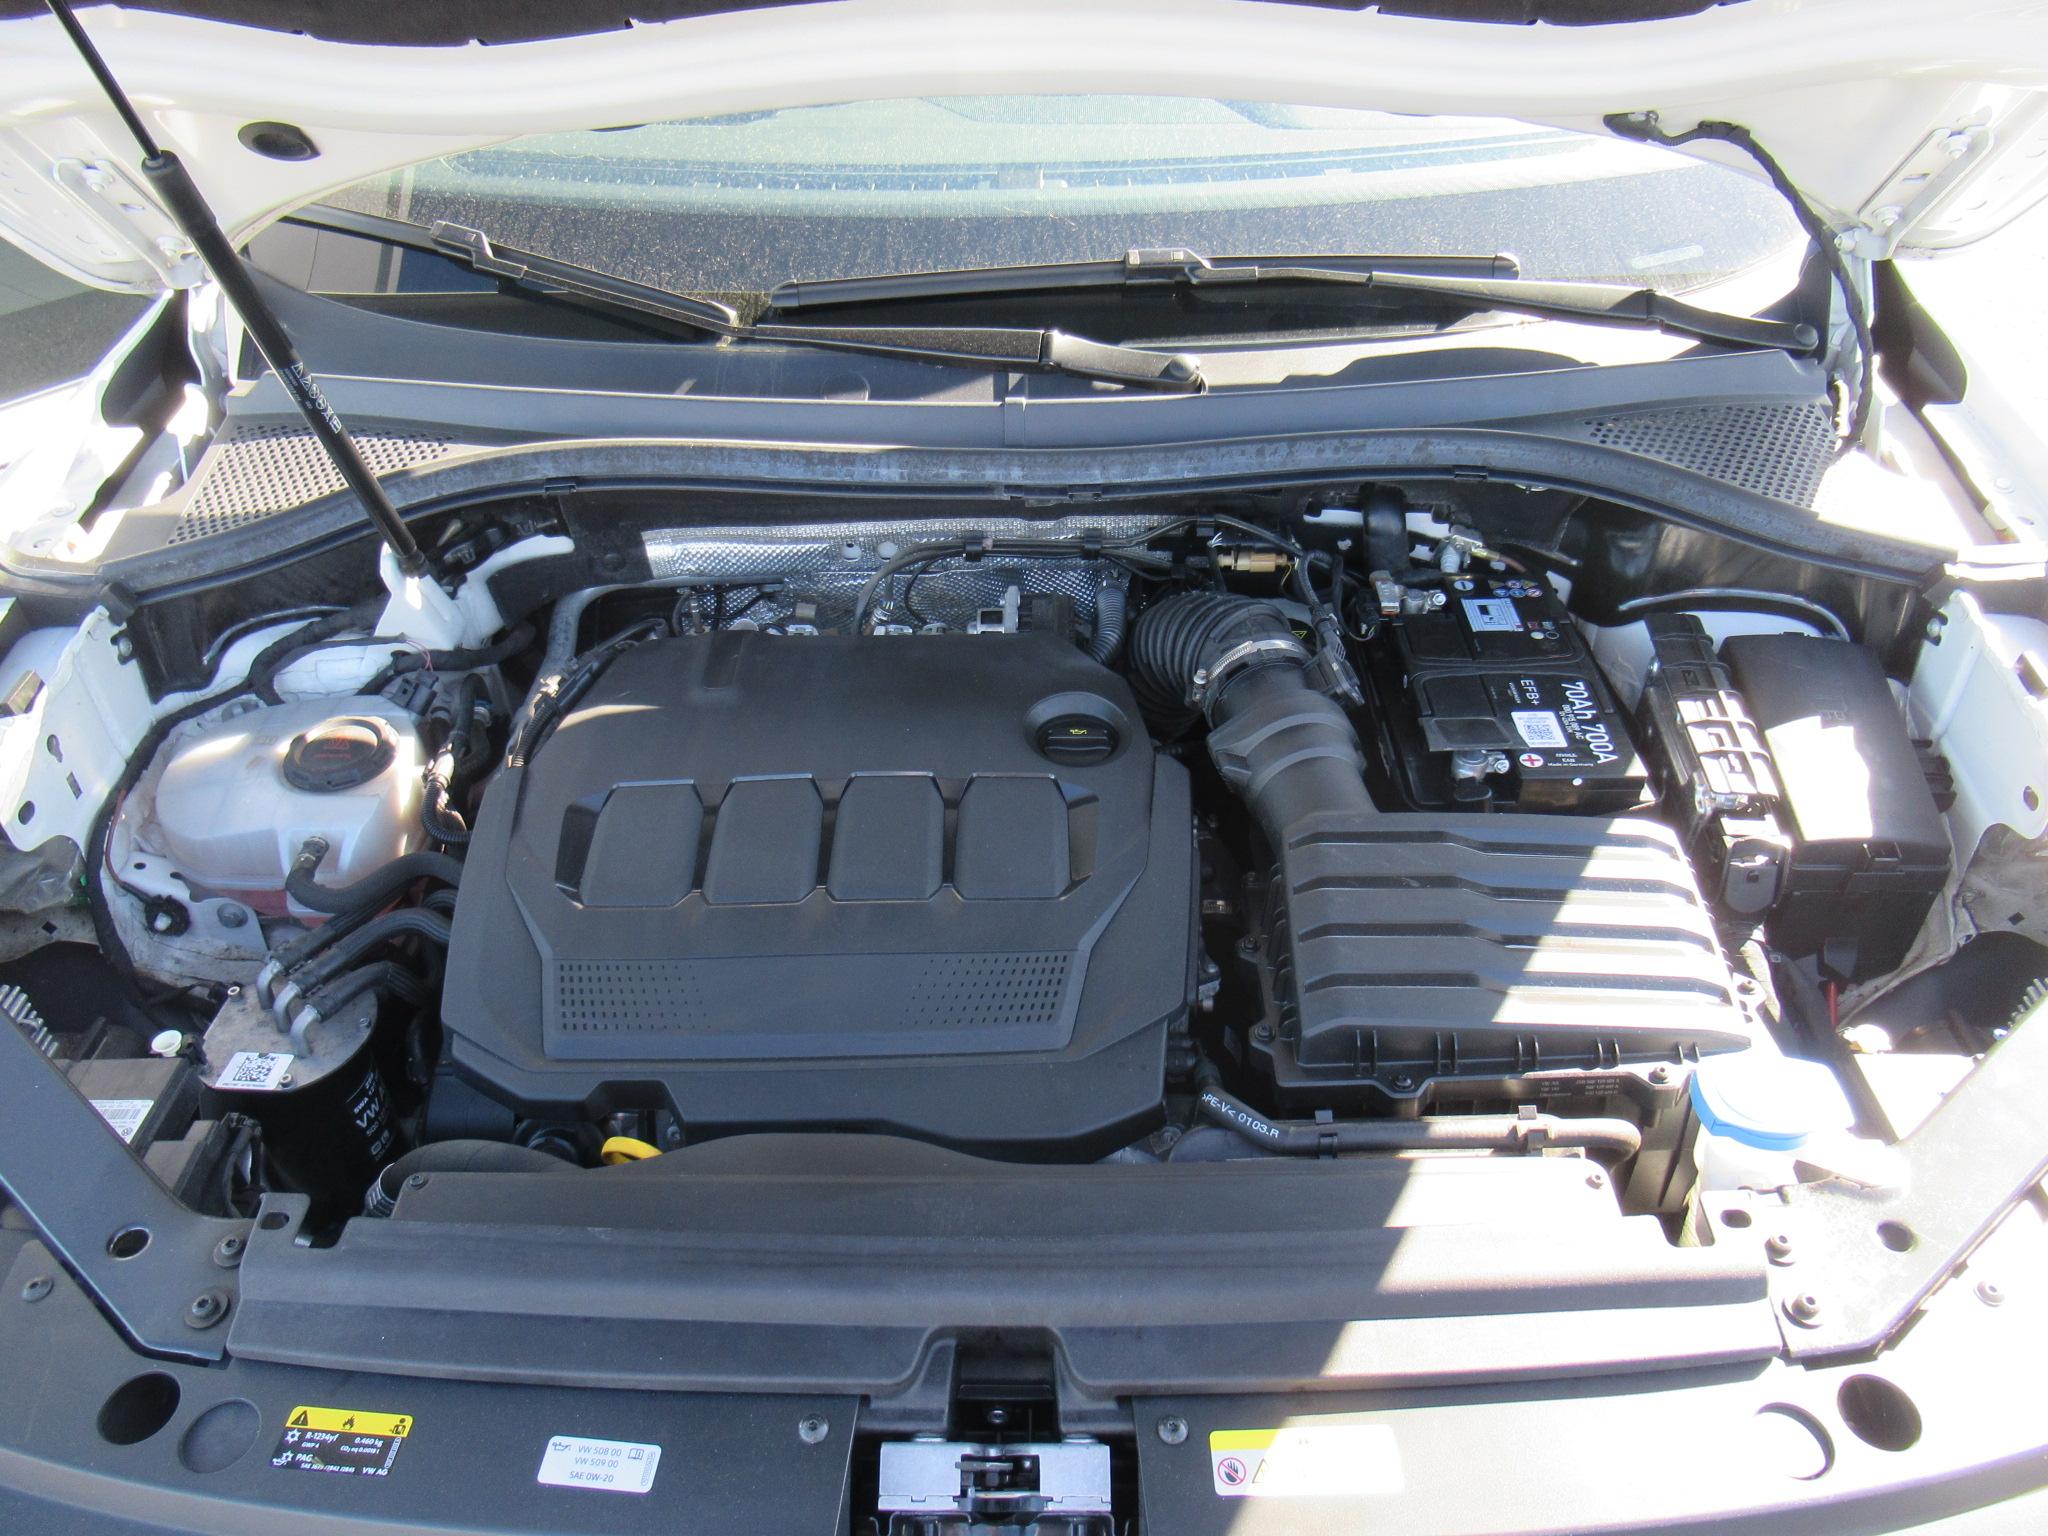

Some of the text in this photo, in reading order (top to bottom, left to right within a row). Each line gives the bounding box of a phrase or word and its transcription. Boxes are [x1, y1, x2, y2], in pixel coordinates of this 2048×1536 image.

[1521, 679, 1540, 705] EFB+
[1560, 681, 1597, 720] 70Ah
[1581, 723, 1619, 764] 700A
[355, 1098, 379, 1128] VW
[305, 1431, 384, 1447] R-1234yf 0.460 kg
[295, 1454, 314, 1462] PAG
[578, 1445, 622, 1457] VW 508 00
[575, 1457, 619, 1468] VW 509 00
[569, 1471, 614, 1482] SAE 0W-20
